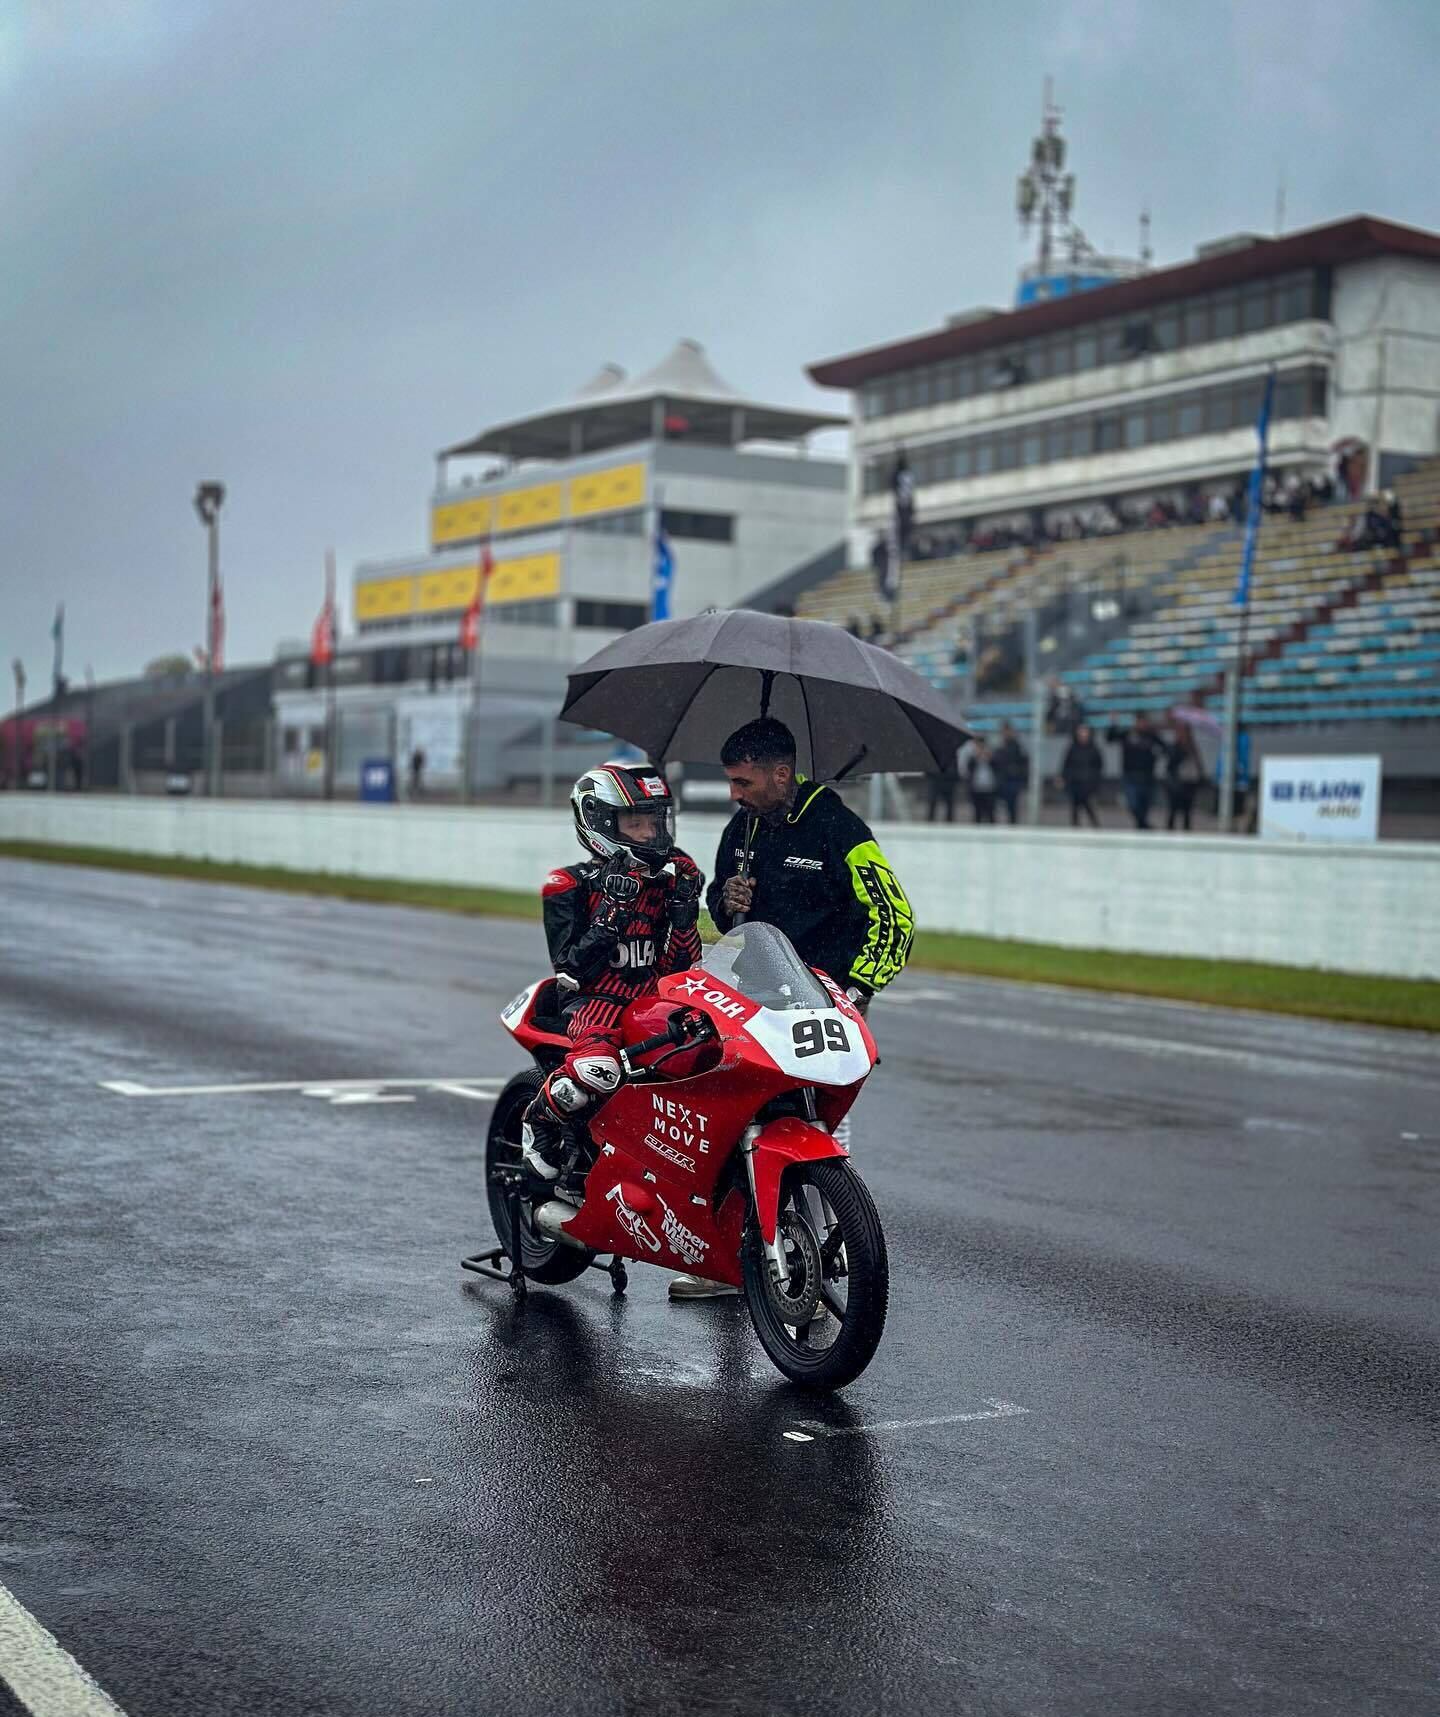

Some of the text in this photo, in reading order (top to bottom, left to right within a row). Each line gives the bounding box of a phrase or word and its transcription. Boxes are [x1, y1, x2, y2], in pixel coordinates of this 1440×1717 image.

[591, 840, 606, 854] BELL
[703, 990, 745, 1019] OLH
[792, 1018, 850, 1059] 99
[652, 1093, 708, 1132] NEXT
[654, 1116, 710, 1154] MOVE
